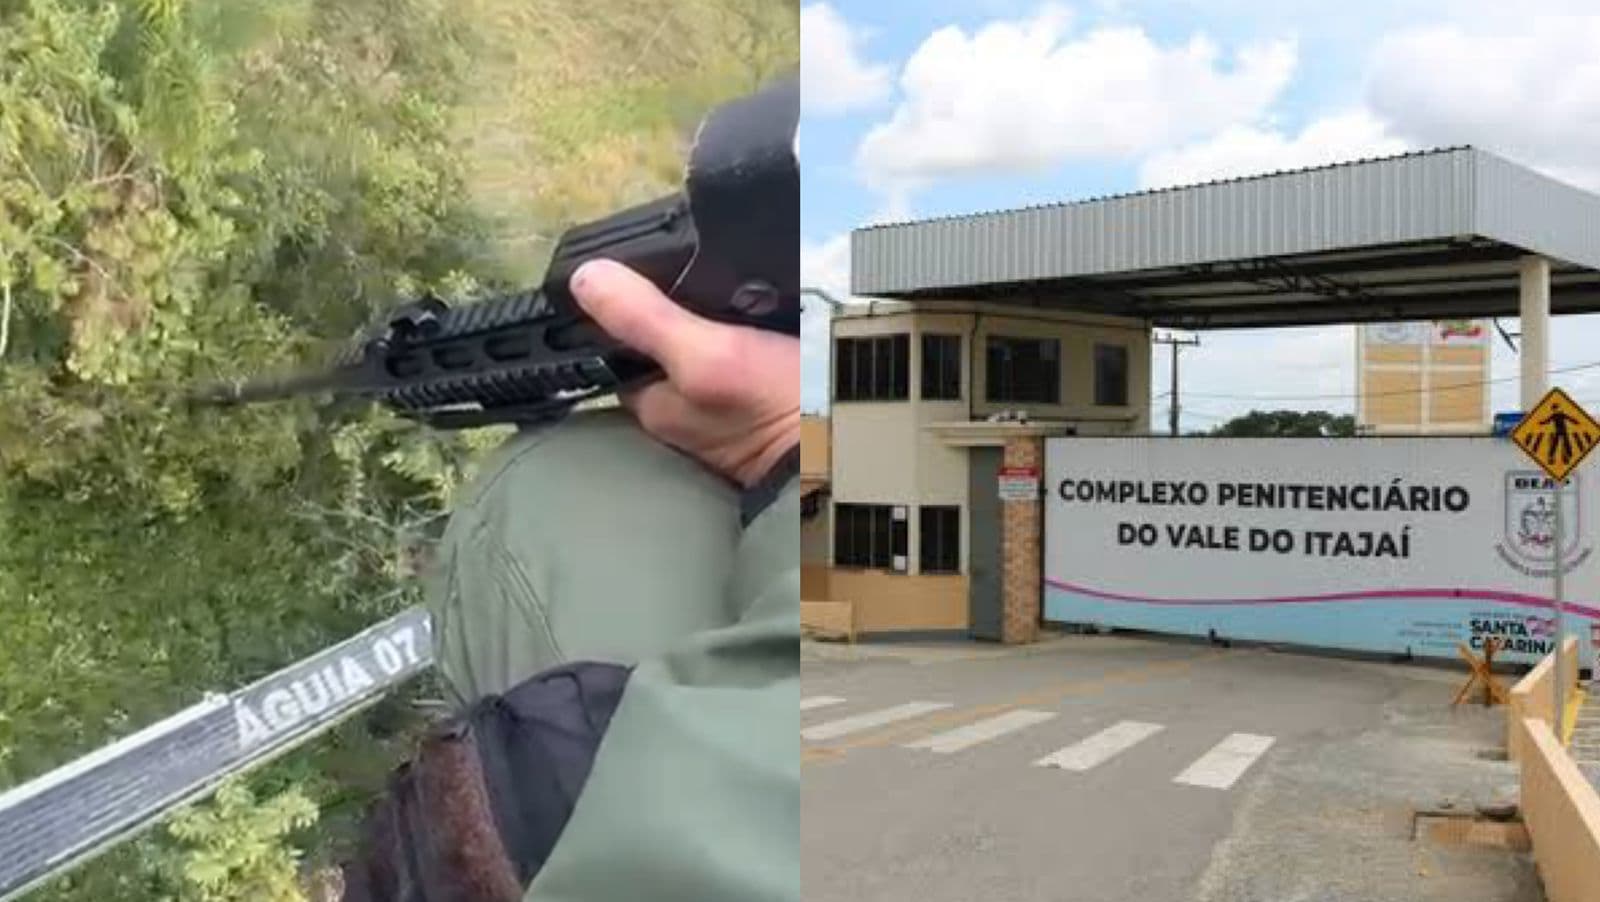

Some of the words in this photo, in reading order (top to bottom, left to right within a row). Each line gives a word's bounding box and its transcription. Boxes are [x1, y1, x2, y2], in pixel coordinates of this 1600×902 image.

[1059, 478, 1209, 505] COMPLEXO
[1217, 477, 1470, 512] PENITENCIÁRIO
[1515, 478, 1571, 490] DEA
[1117, 523, 1158, 546] DO
[1166, 524, 1240, 551] VALE
[1249, 528, 1294, 554] DO
[1304, 524, 1411, 559] ITAJAÍ
[1470, 619, 1529, 636] SANTA
[1470, 636, 1556, 654] CTARIN
[233, 656, 375, 750] ÁGUIA
[372, 626, 419, 676] 07
